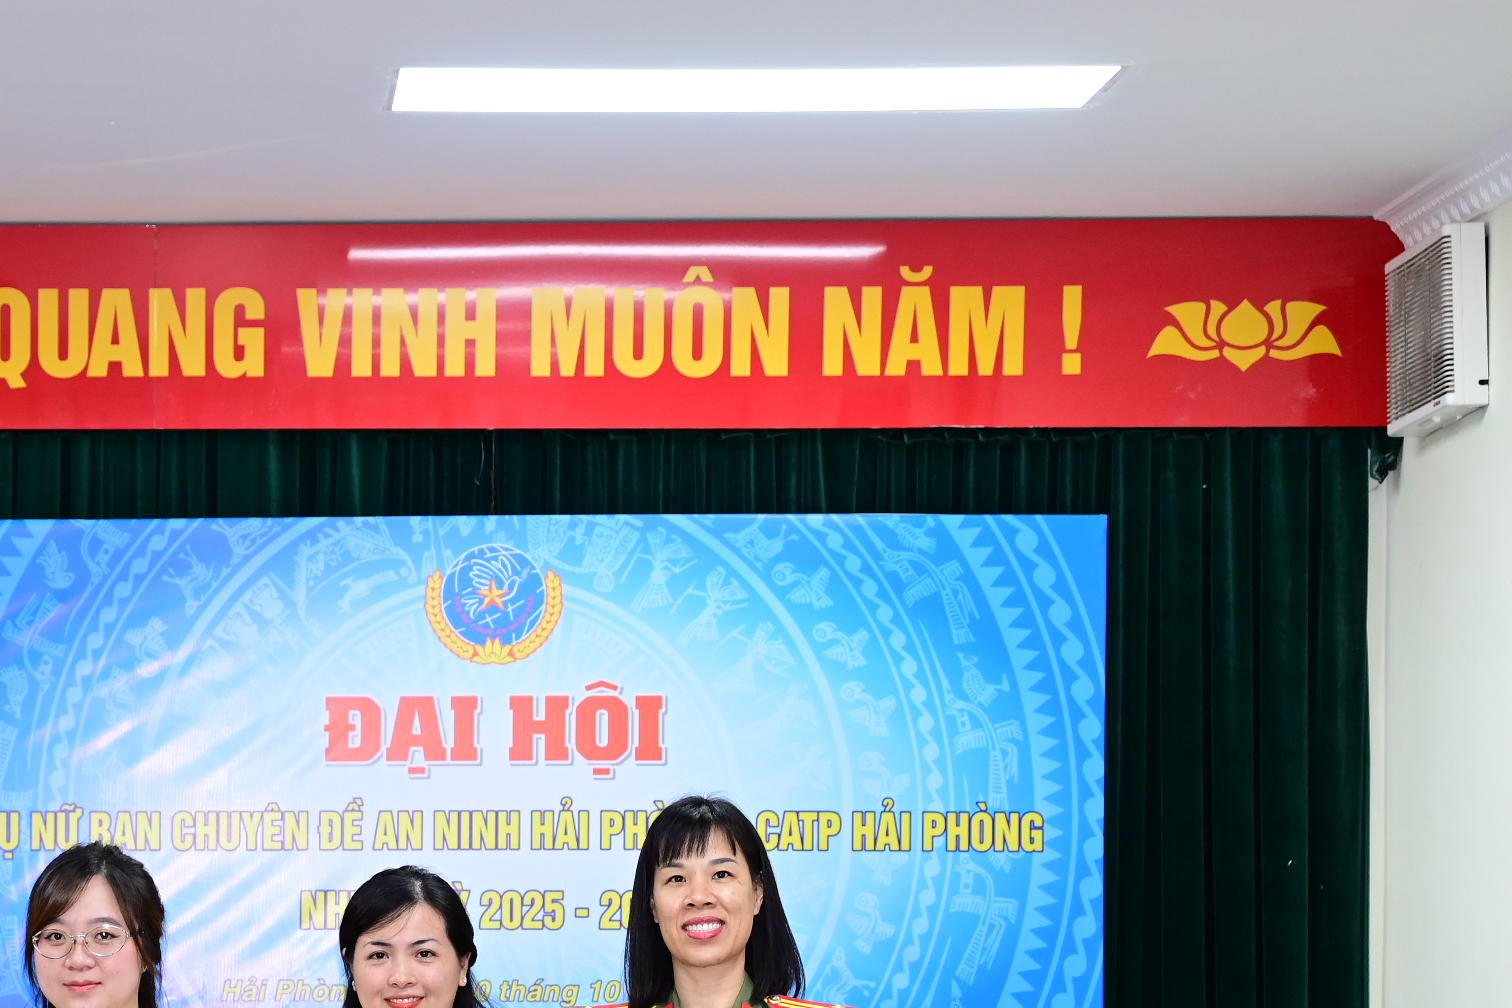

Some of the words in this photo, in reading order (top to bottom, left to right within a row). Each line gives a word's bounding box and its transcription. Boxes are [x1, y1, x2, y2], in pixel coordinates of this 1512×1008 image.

[296, 287, 497, 378] VINH
[530, 265, 790, 379] MUÔN
[822, 264, 1026, 377] NĂM
[1061, 285, 1083, 375] !
[324, 695, 479, 775] ĐẠI
[508, 680, 664, 776] HỘI
[31, 803, 83, 851] NỮ
[89, 811, 161, 851] BAN
[171, 802, 308, 851] CHUYÊN
[318, 797, 364, 851] ĐỀ
[373, 810, 423, 851] AN
[433, 810, 520, 850] NINH
[531, 797, 589, 851] HẢI
[756, 811, 841, 851] CATP
[851, 797, 910, 852] HẢI
[922, 801, 1044, 852] PHÒNG
[479, 889, 565, 930] 2025
[223, 976, 268, 1002] Hải
[275, 976, 349, 1002] Phòn
[499, 979, 580, 1006] tháng
[591, 979, 622, 1001] 10
